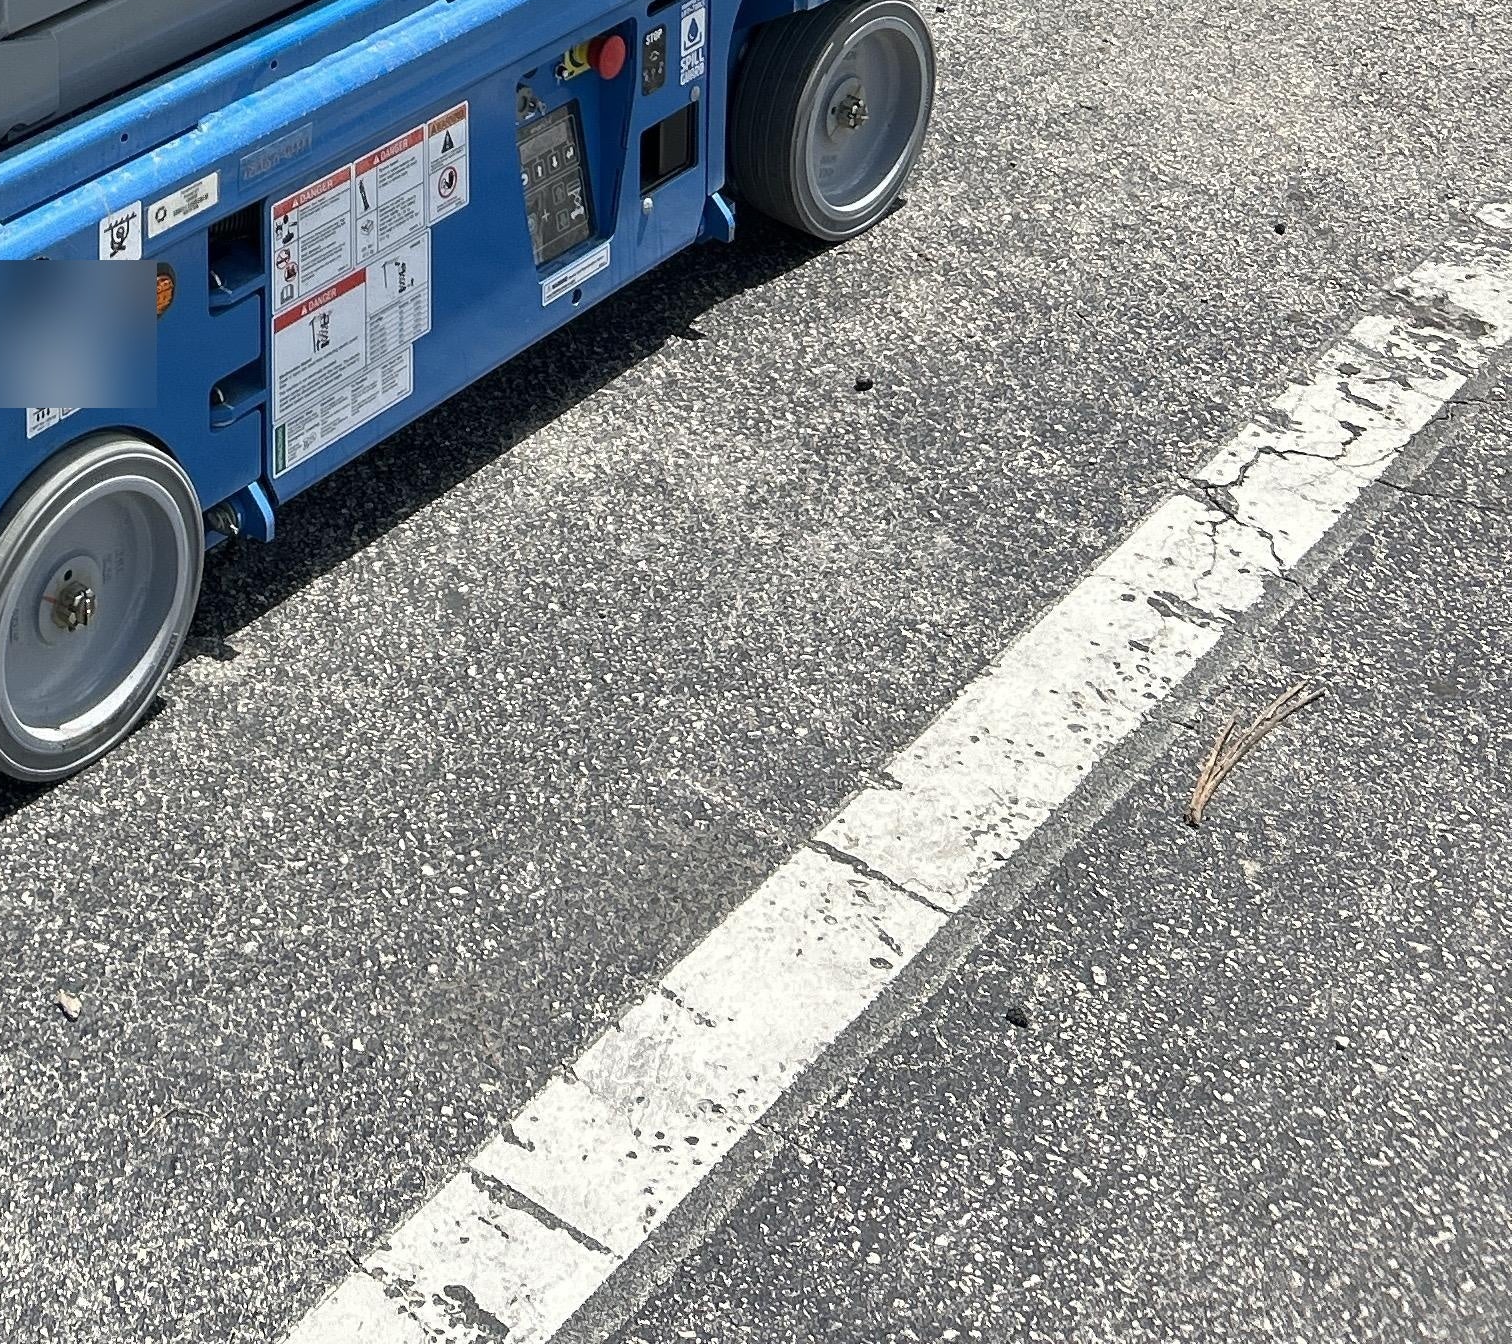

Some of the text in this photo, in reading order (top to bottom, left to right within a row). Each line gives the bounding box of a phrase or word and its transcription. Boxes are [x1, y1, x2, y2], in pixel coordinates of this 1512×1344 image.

[645, 28, 663, 46] STOP
[680, 47, 705, 72] SPILL
[299, 179, 334, 205] DANGER
[308, 287, 338, 311] DANGER
